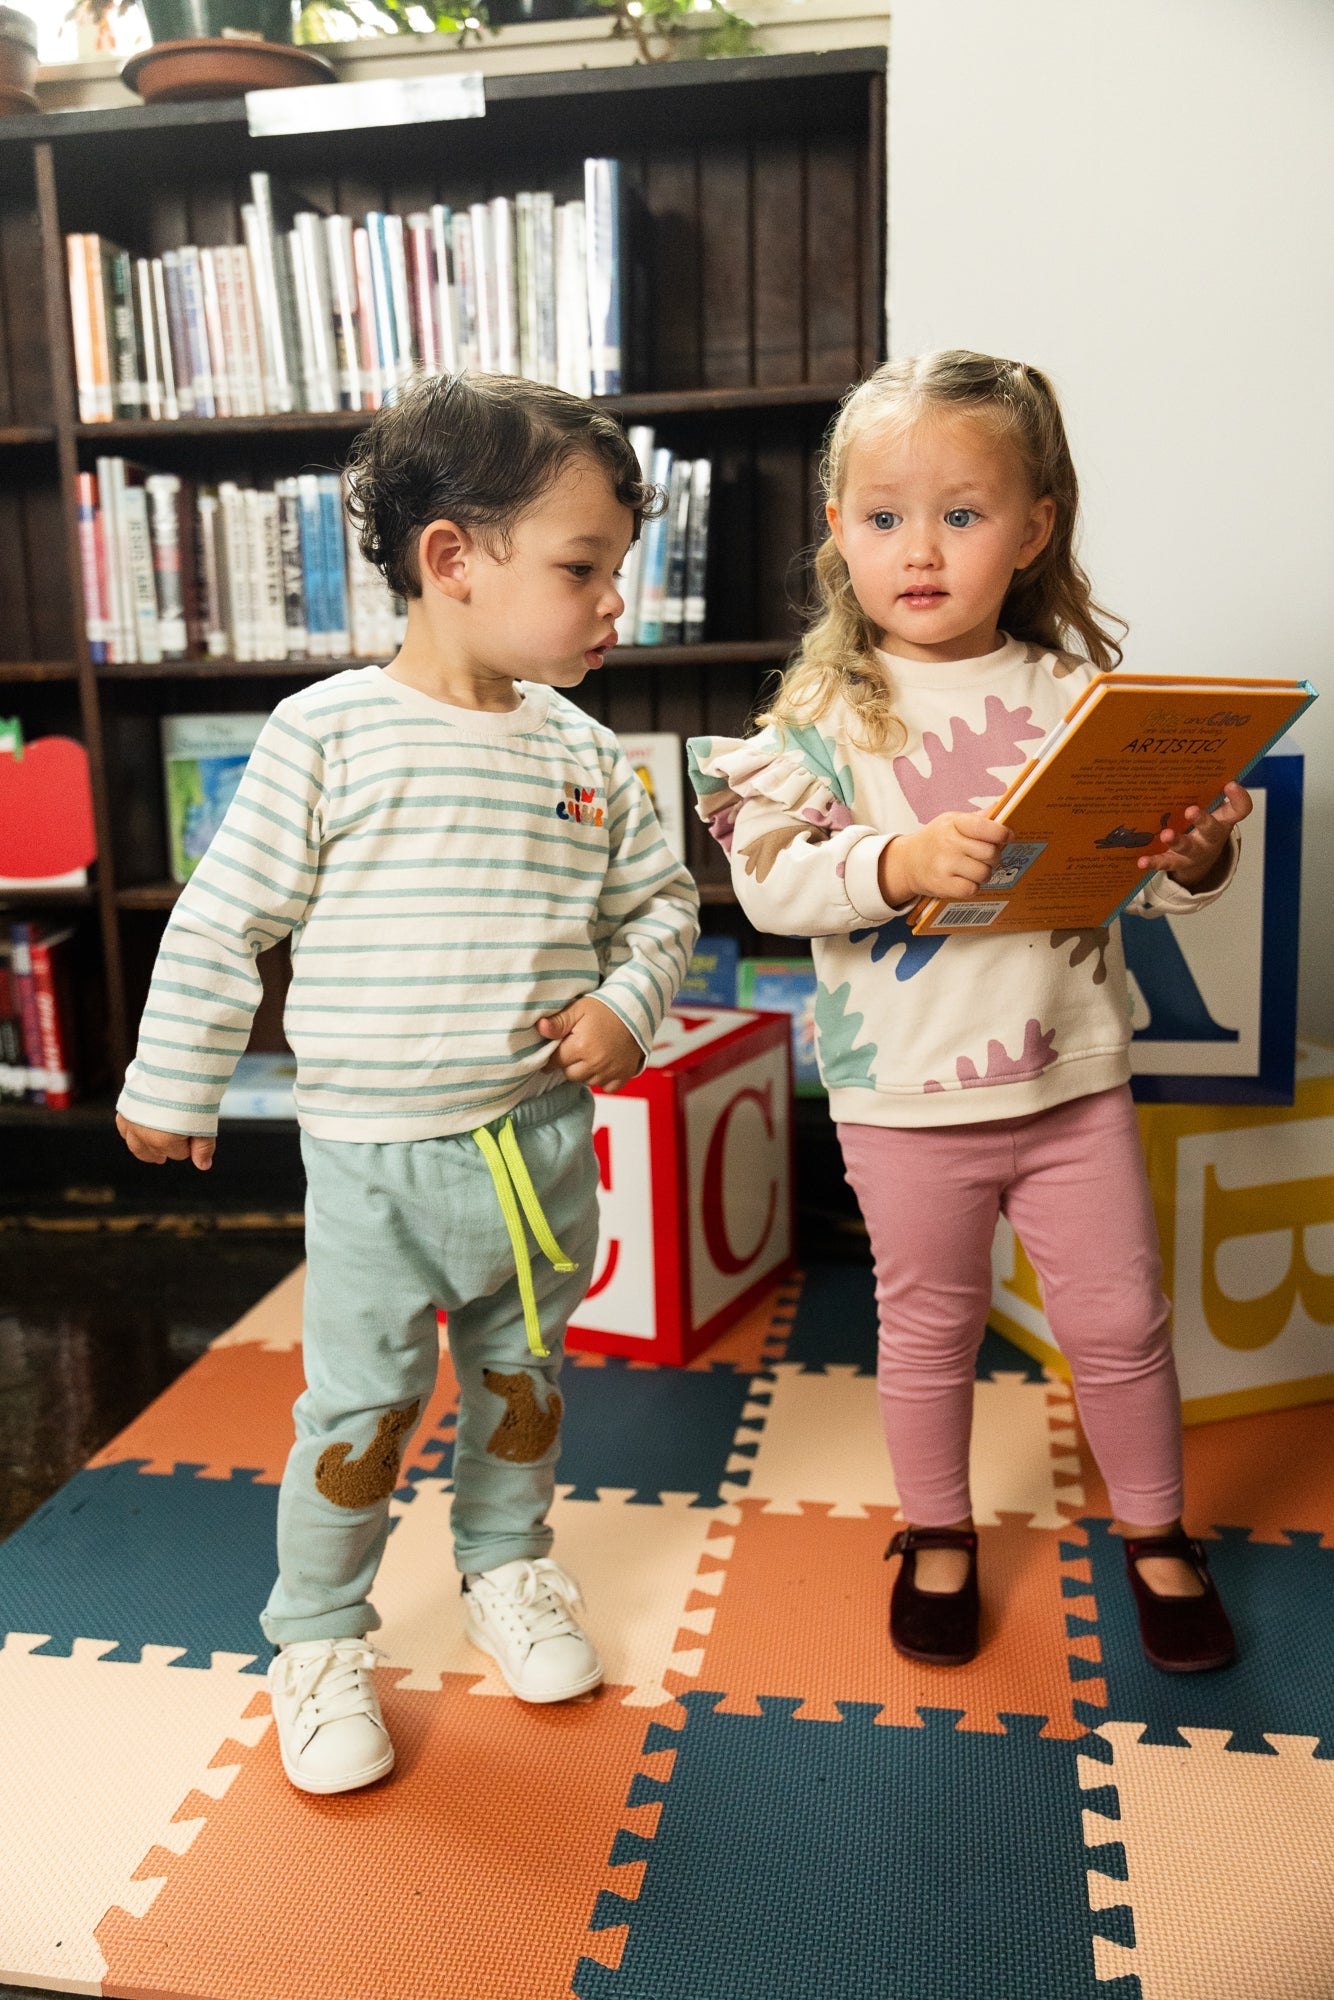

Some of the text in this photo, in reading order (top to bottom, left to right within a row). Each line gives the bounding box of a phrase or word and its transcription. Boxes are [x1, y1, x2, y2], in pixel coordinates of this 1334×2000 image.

[1184, 714, 1209, 725] and
[1207, 711, 1251, 727] Cleo
[1120, 738, 1228, 754] ARTISTIC!
[702, 1079, 777, 1277] C
